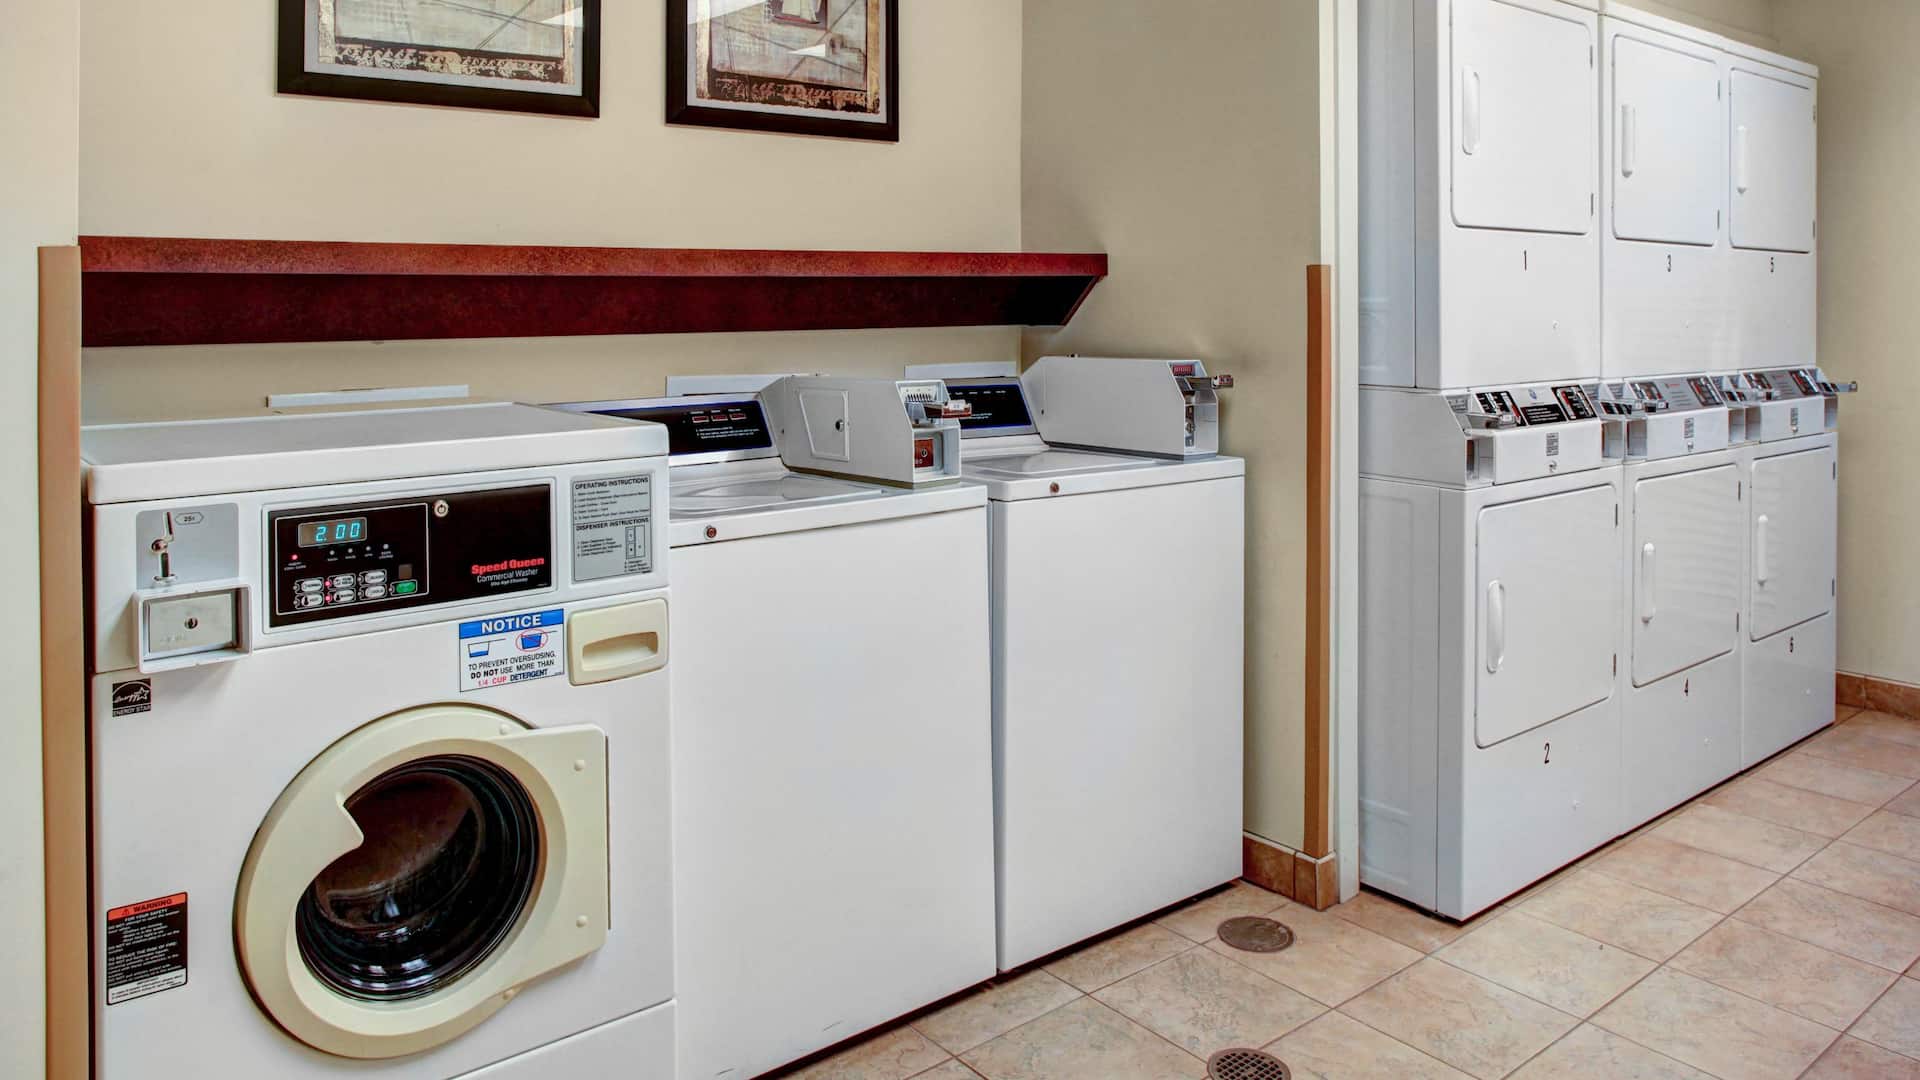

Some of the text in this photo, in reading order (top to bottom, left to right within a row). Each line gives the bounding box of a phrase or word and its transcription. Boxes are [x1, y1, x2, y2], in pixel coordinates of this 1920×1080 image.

[1523, 249, 1528, 272] 1
[1666, 254, 1672, 273] 3
[575, 477, 648, 490] OPERATING INSTRUCTIONS
[576, 517, 649, 532] DISPENSER INSTRUCTIONS
[471, 557, 545, 575] Speed Queen
[476, 568, 538, 583] Commercial Washer
[481, 614, 542, 634] NOTICE
[468, 663, 477, 671] TO
[479, 658, 509, 669] PREVENT
[471, 671, 482, 680] DO
[483, 668, 499, 677] NOT
[516, 663, 535, 672] MORE
[537, 659, 554, 668] THAN
[477, 679, 488, 687] 1/4
[492, 676, 507, 684] CUP
[510, 668, 549, 681] DETERGENT
[1684, 678, 1689, 696] 4
[1544, 742, 1550, 764] 2
[133, 899, 173, 912] WARNING
